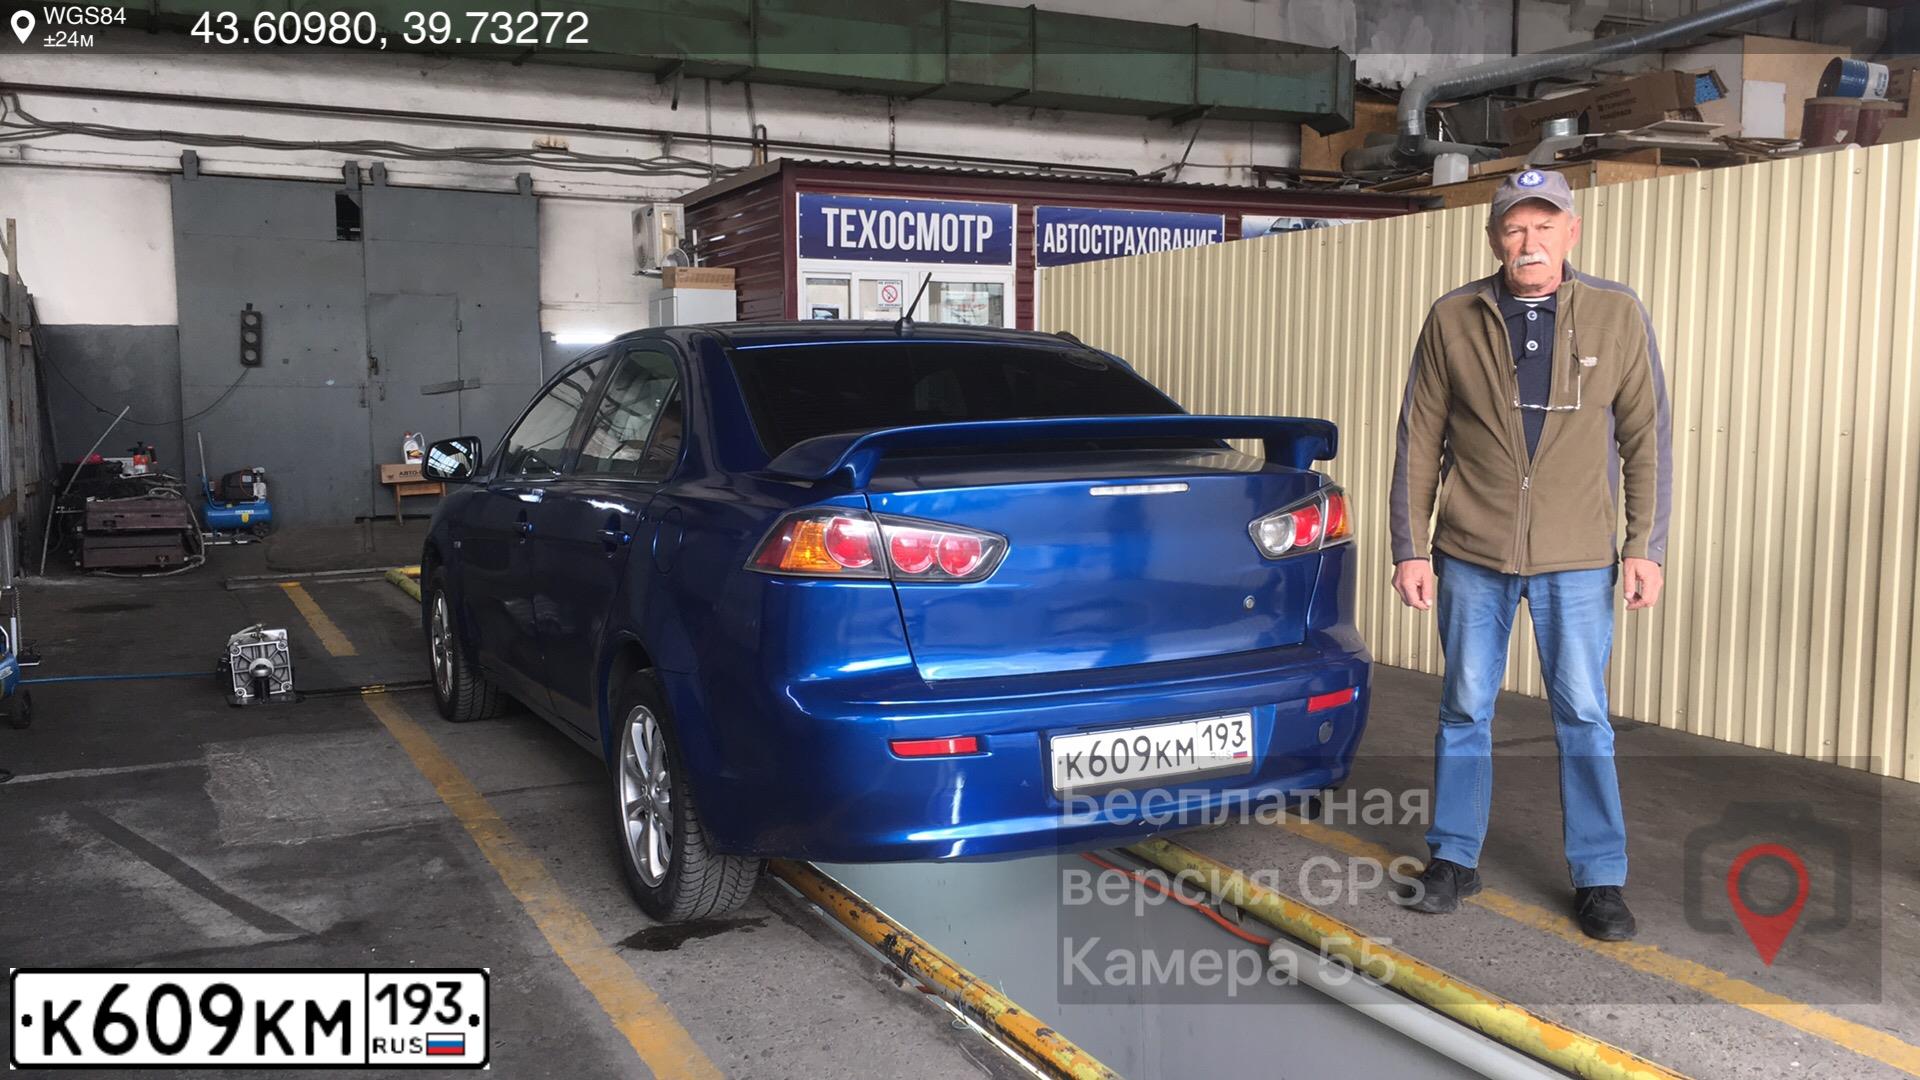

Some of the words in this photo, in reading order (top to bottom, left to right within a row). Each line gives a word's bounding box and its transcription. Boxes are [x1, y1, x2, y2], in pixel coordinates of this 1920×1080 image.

[821, 207, 993, 253] ТЕХОСМОТР
[1043, 223, 1218, 256] АВТОСТРАХОВАНИЕ
[1066, 735, 1195, 781] К609КМ
[1202, 720, 1246, 752] 193
